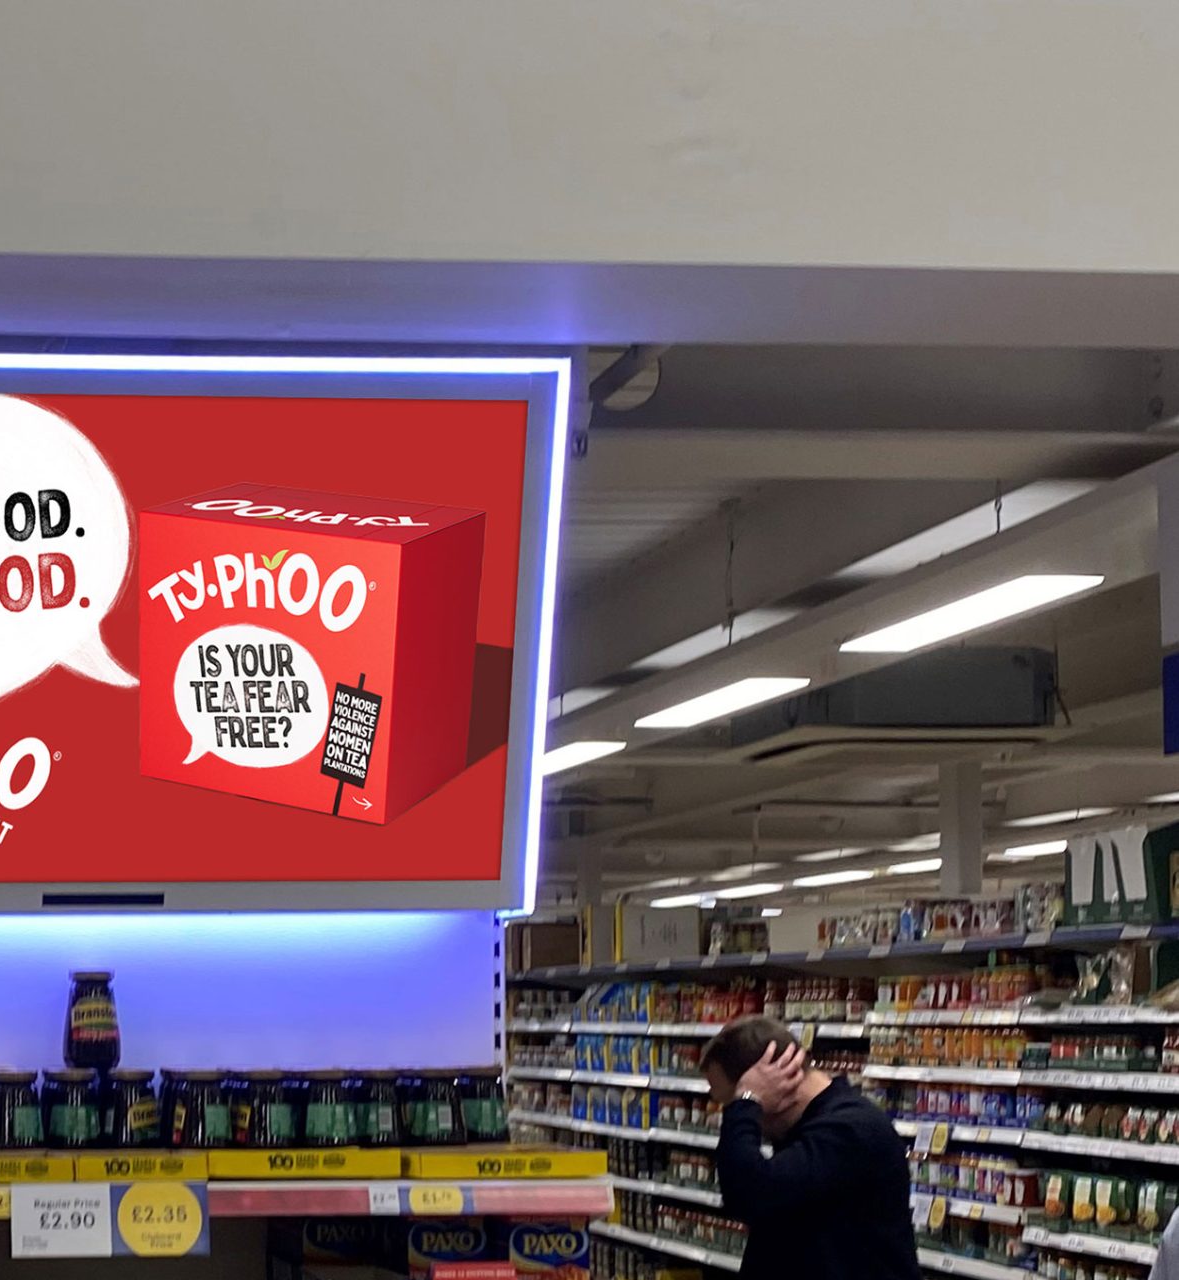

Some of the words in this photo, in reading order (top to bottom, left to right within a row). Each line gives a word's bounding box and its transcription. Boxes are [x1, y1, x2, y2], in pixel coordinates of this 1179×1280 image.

[198, 644, 222, 677] IS
[225, 643, 295, 677] YOUR
[190, 680, 240, 713] TEA
[243, 680, 311, 713] FEAR
[335, 690, 350, 705] NO
[351, 696, 378, 716] MORE
[331, 715, 374, 740] AGAINST
[334, 703, 376, 728] VIOLENCE
[214, 716, 292, 748] FREE?
[328, 728, 372, 755] WOMEN
[323, 757, 366, 779] PLANTATIONS
[326, 743, 344, 761] ON
[346, 749, 367, 770] TEA
[104, 1158, 131, 1176] 100
[477, 1159, 502, 1175] 100
[39, 1210, 95, 1231] £2.90
[422, 1232, 475, 1252] PAXO
[523, 1232, 577, 1256] PAXO
